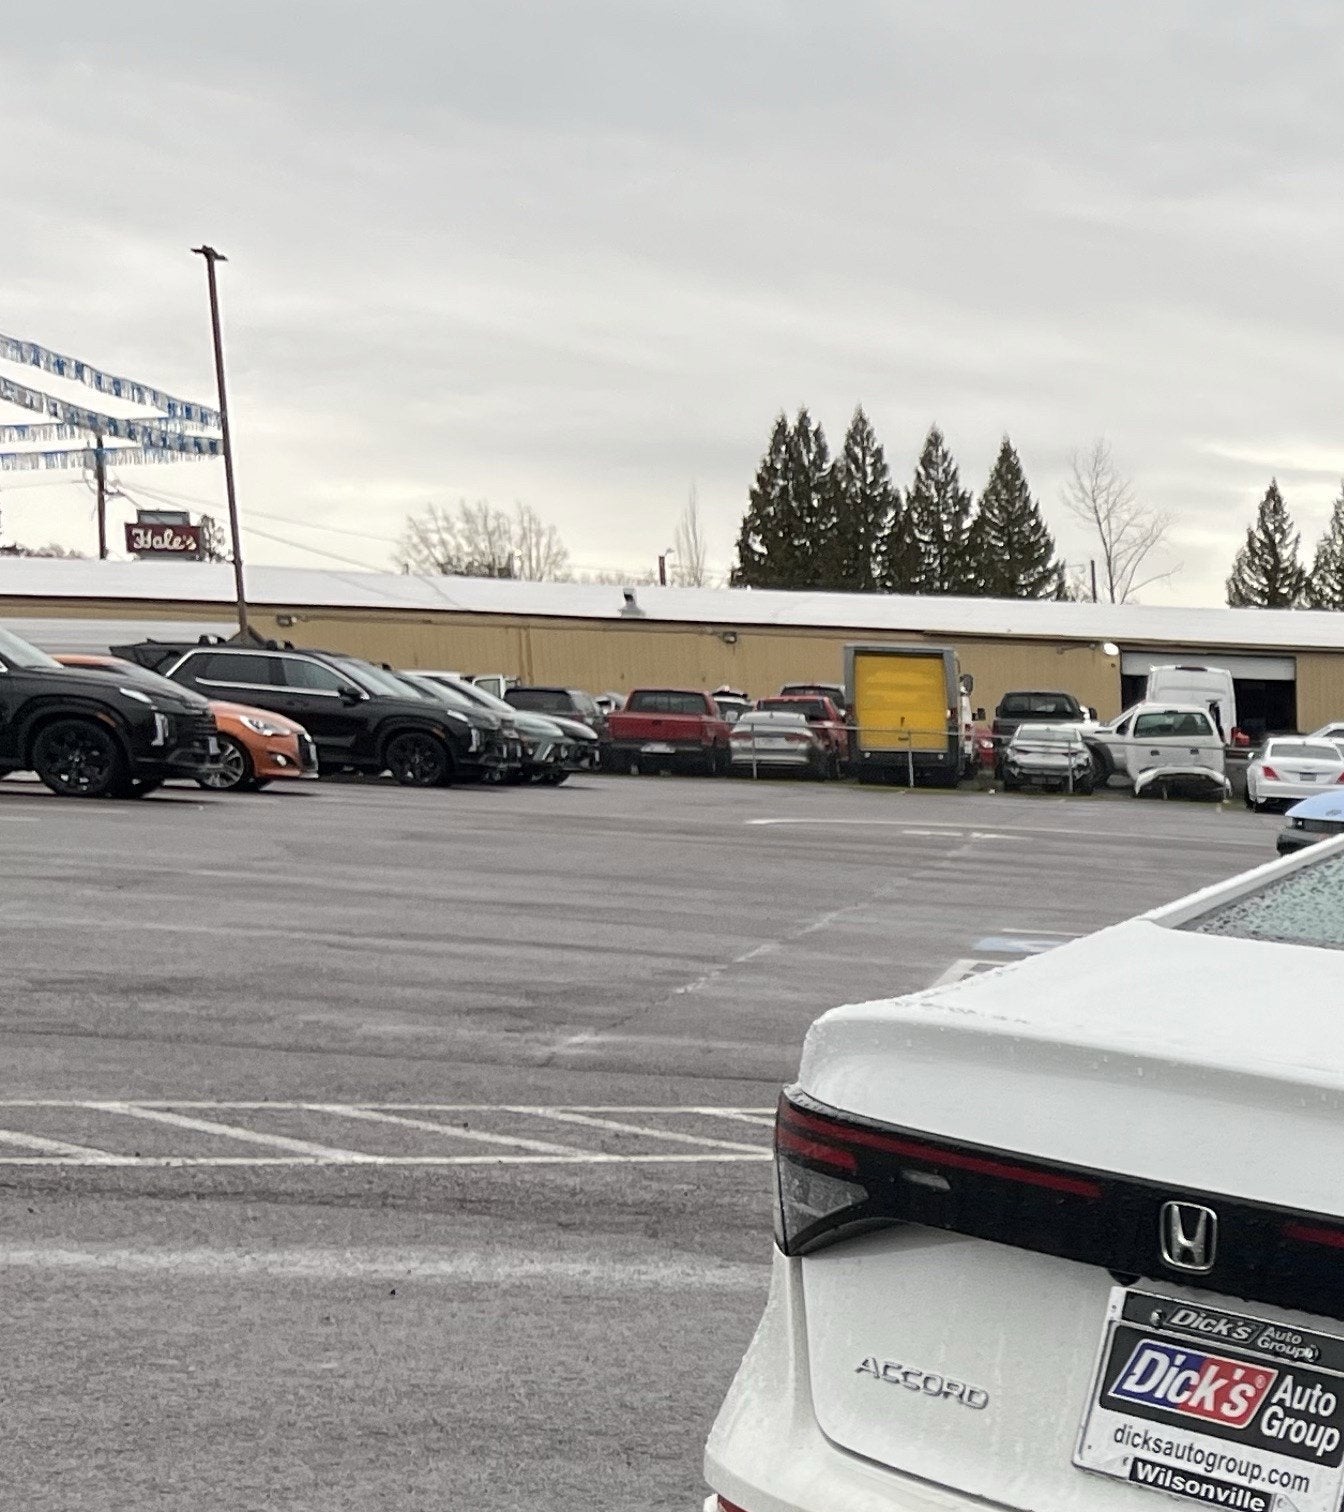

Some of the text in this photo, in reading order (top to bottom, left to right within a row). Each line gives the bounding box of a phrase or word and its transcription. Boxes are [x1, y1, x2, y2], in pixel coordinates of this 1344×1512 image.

[131, 528, 197, 551] Hale's
[1170, 1309, 1252, 1341] Dick's
[1263, 1327, 1303, 1345] Auto
[854, 1356, 990, 1410] ACCORD
[1122, 1348, 1257, 1418] Dick's
[1271, 1374, 1337, 1418] Auto
[1260, 1406, 1341, 1457] Group
[1113, 1423, 1310, 1494] dicksautogroup.com
[1136, 1461, 1266, 1512] Wilsonville
